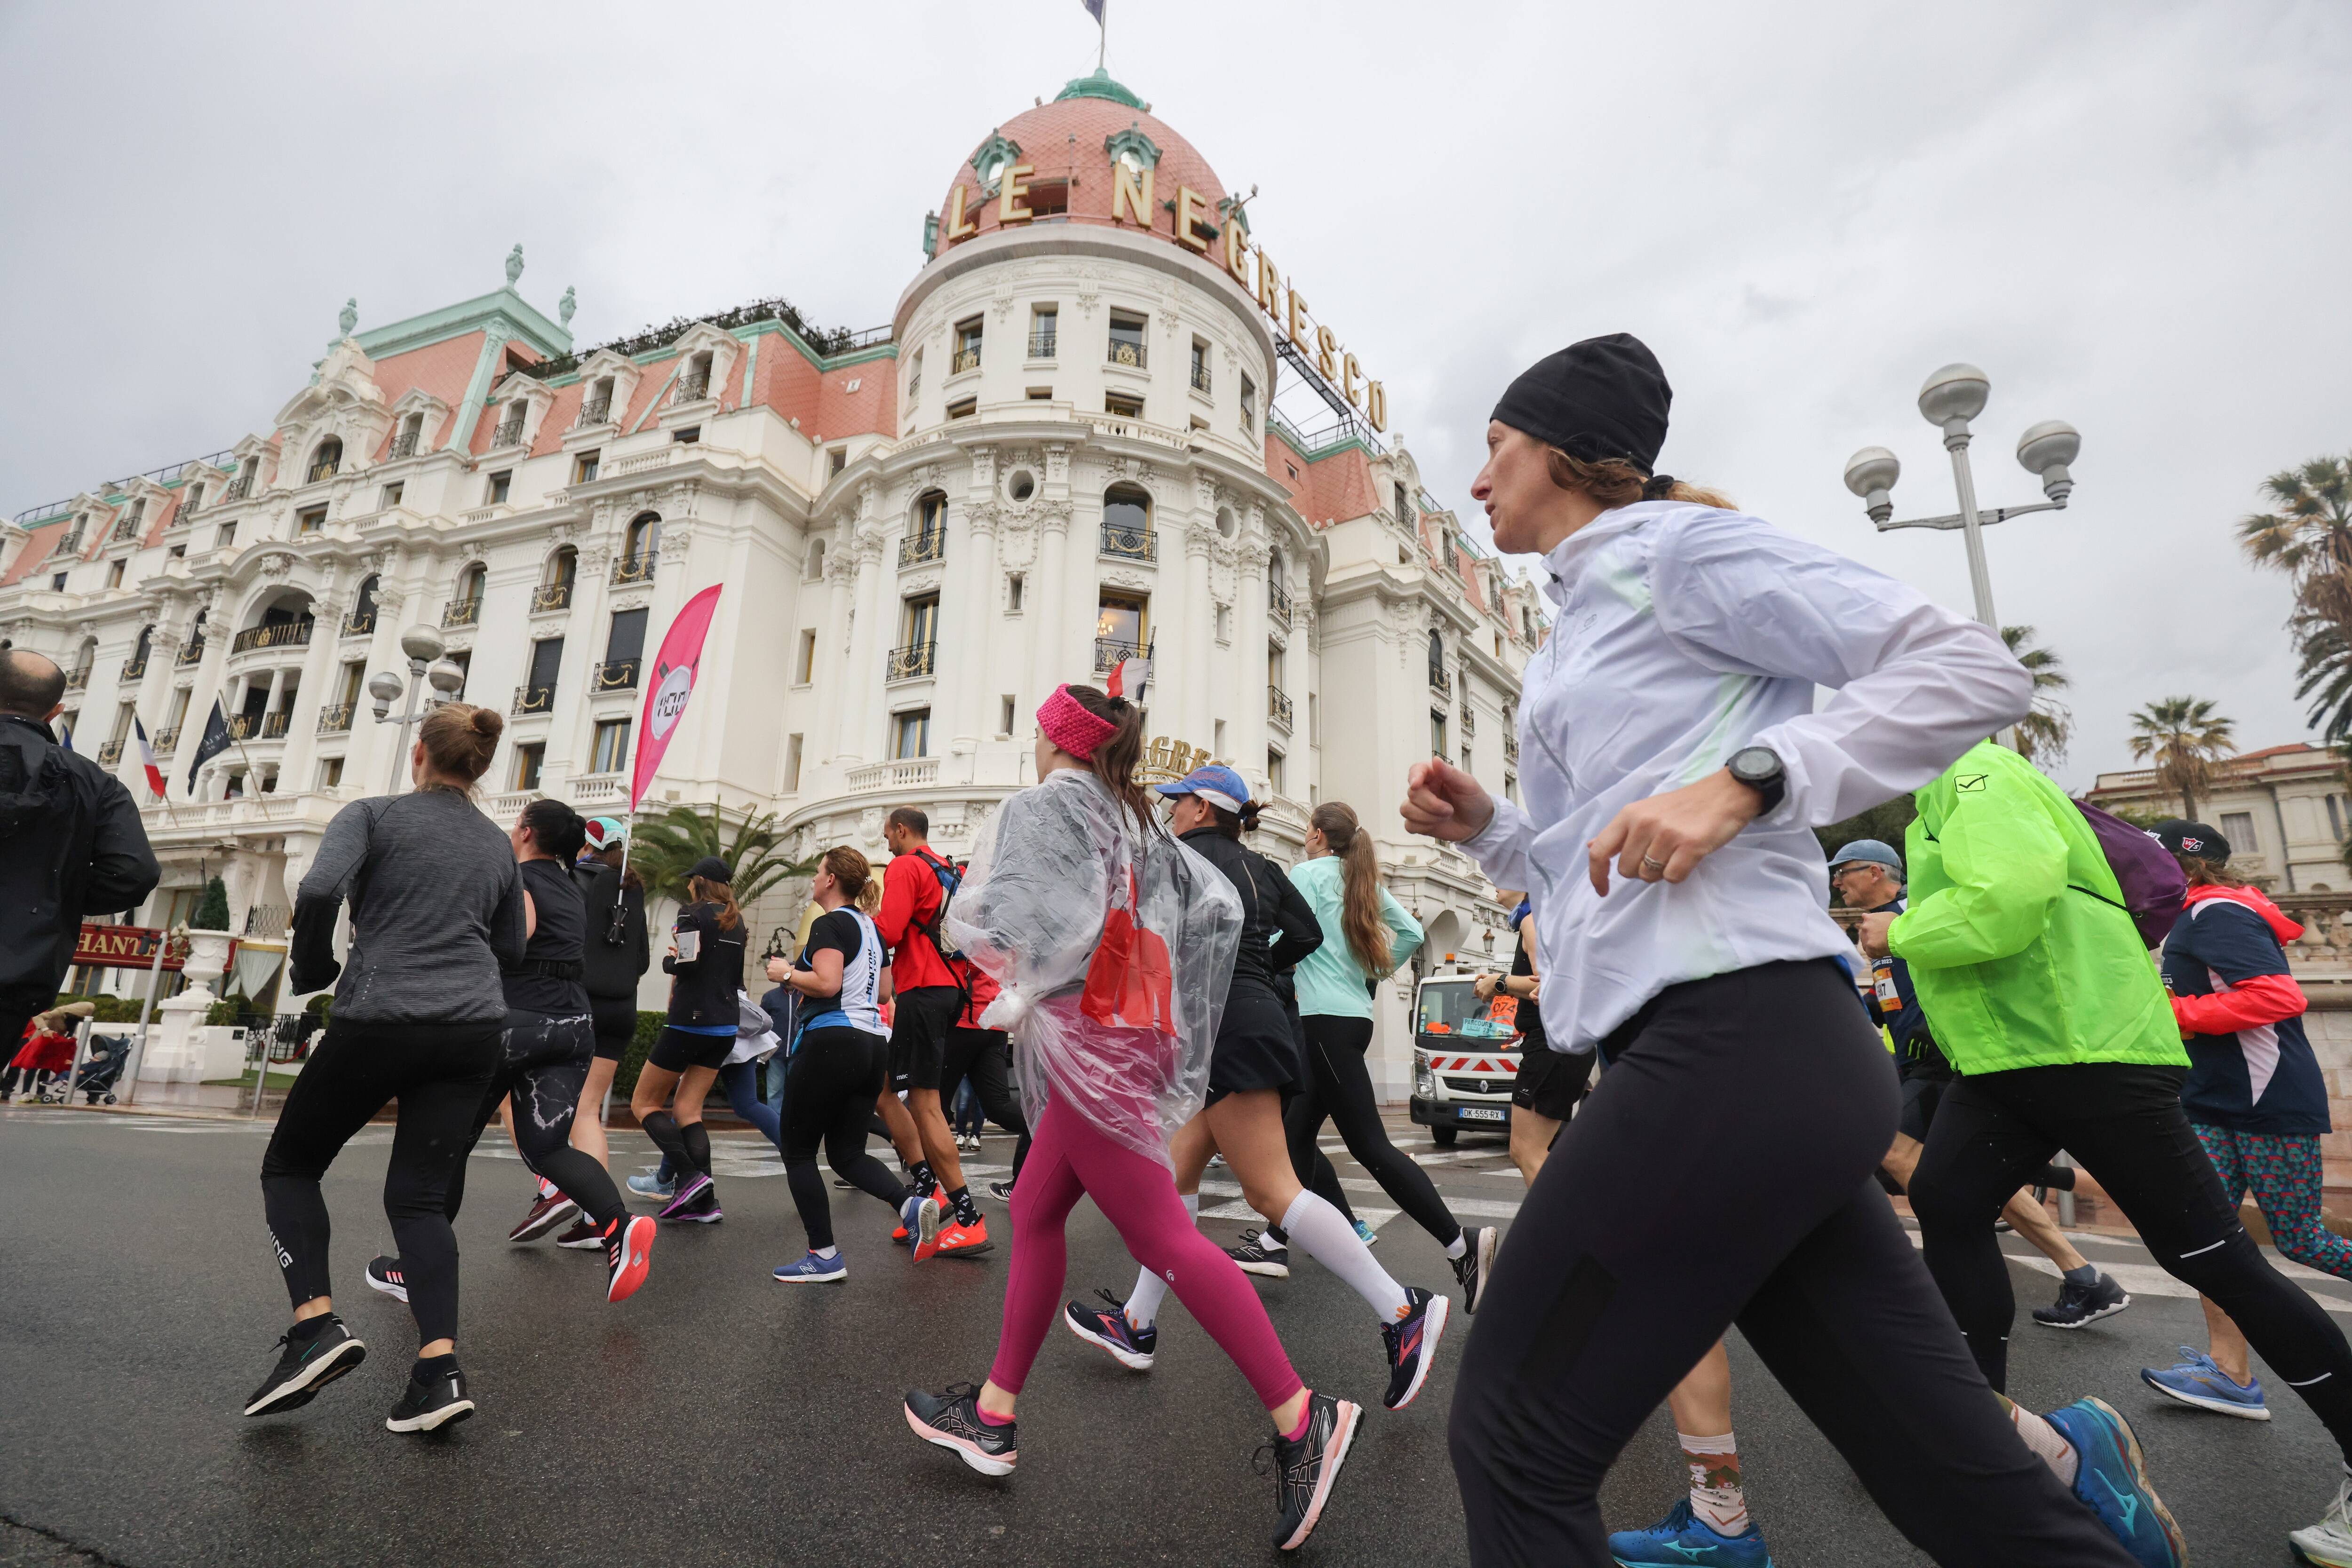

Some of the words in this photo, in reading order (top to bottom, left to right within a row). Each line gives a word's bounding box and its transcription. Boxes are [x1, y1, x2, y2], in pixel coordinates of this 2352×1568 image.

[947, 164, 1035, 242] LE
[1112, 161, 1388, 433] NEGRESCO
[1135, 735, 1226, 774] GRE
[76, 933, 184, 958] HANTEC
[866, 949, 876, 995] MENTON
[1493, 1002, 1516, 1013] 074
[1464, 1019, 1492, 1028] PARCOURS
[1464, 1109, 1500, 1119] DK-555-RX
